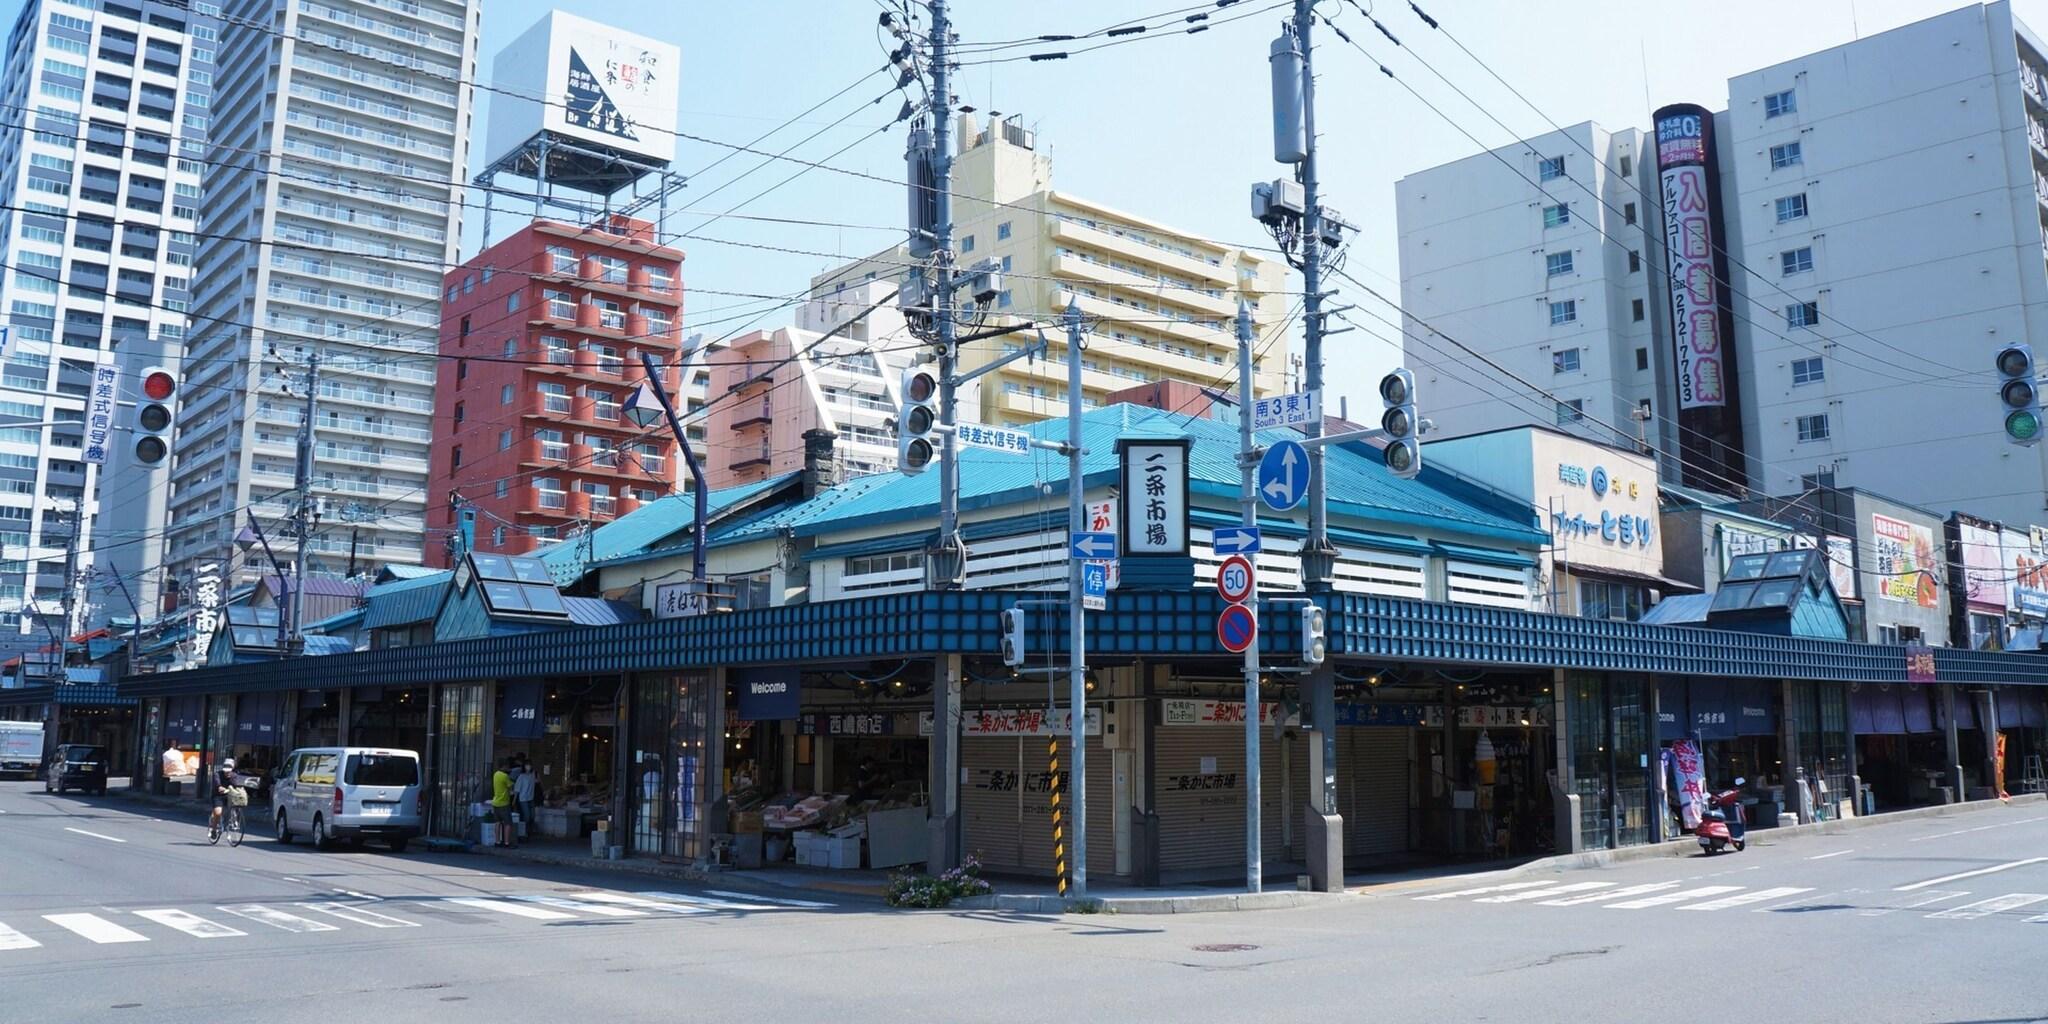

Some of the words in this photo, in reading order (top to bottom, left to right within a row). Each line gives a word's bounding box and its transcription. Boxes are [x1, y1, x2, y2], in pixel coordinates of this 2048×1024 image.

[1664, 174, 1683, 263] アルファコート
[1679, 170, 1724, 402] 入居者募集
[1675, 294, 1692, 402] 272-7733
[86, 367, 115, 461] 時差式信号機
[1255, 418, 1276, 428] South
[1279, 416, 1284, 424] 3
[1288, 412, 1305, 423] East
[959, 425, 1028, 451] 時差式信号機
[1145, 452, 1168, 546] 二条市場
[1088, 570, 1103, 591] 停
[1225, 569, 1245, 590] 50
[193, 563, 221, 656] 二条市場
[751, 682, 787, 694] Welcome
[969, 711, 1041, 733] 二条かに市場
[1202, 702, 1268, 723] 二条かに場
[975, 768, 1070, 794] 二条かに市場
[1165, 773, 1237, 791] 二条かに市場
